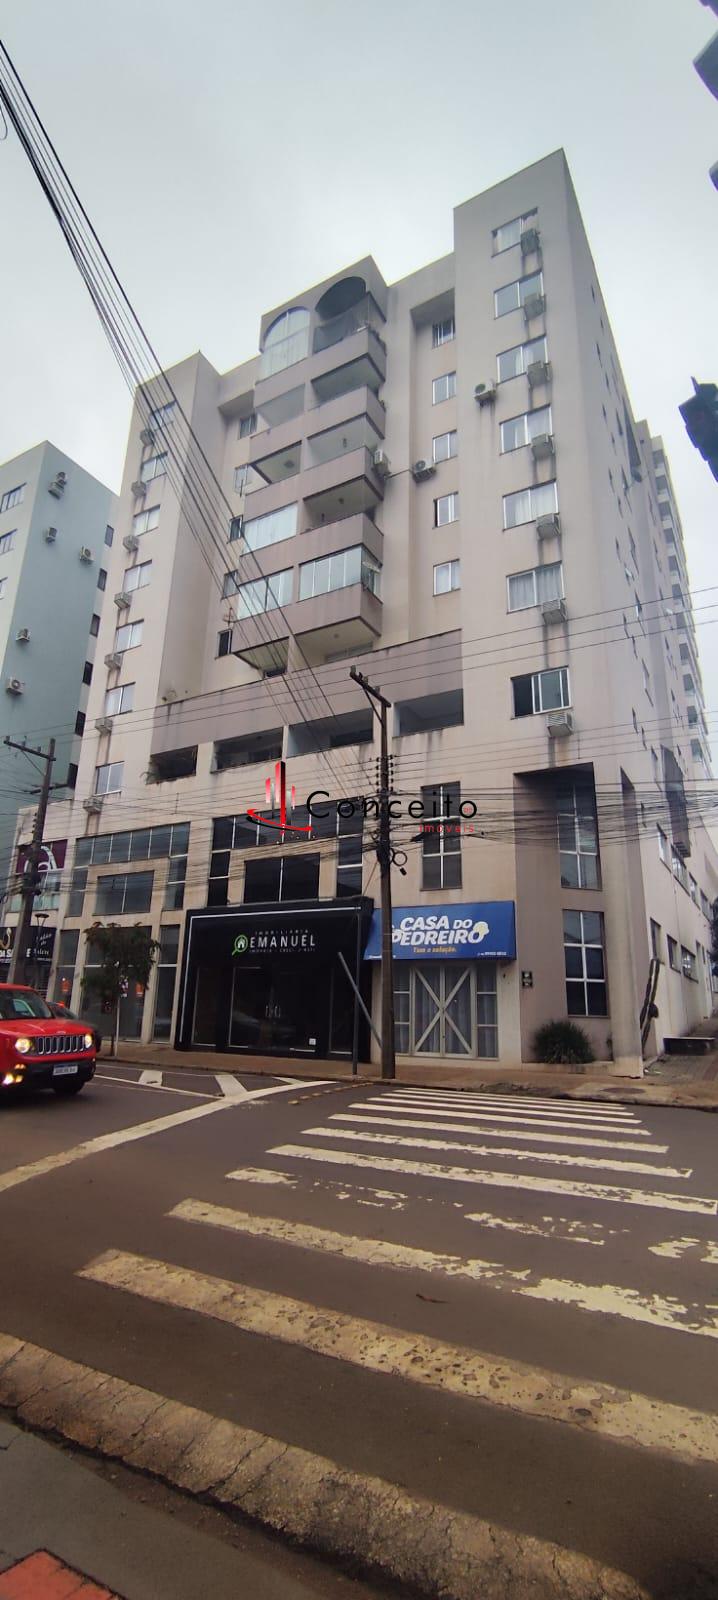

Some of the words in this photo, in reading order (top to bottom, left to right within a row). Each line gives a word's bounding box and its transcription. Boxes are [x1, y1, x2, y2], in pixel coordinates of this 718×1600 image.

[400, 915, 450, 931] CASA
[453, 919, 473, 929] DO
[249, 934, 316, 948] EMANUEL
[391, 929, 486, 946] PEDREIRO
